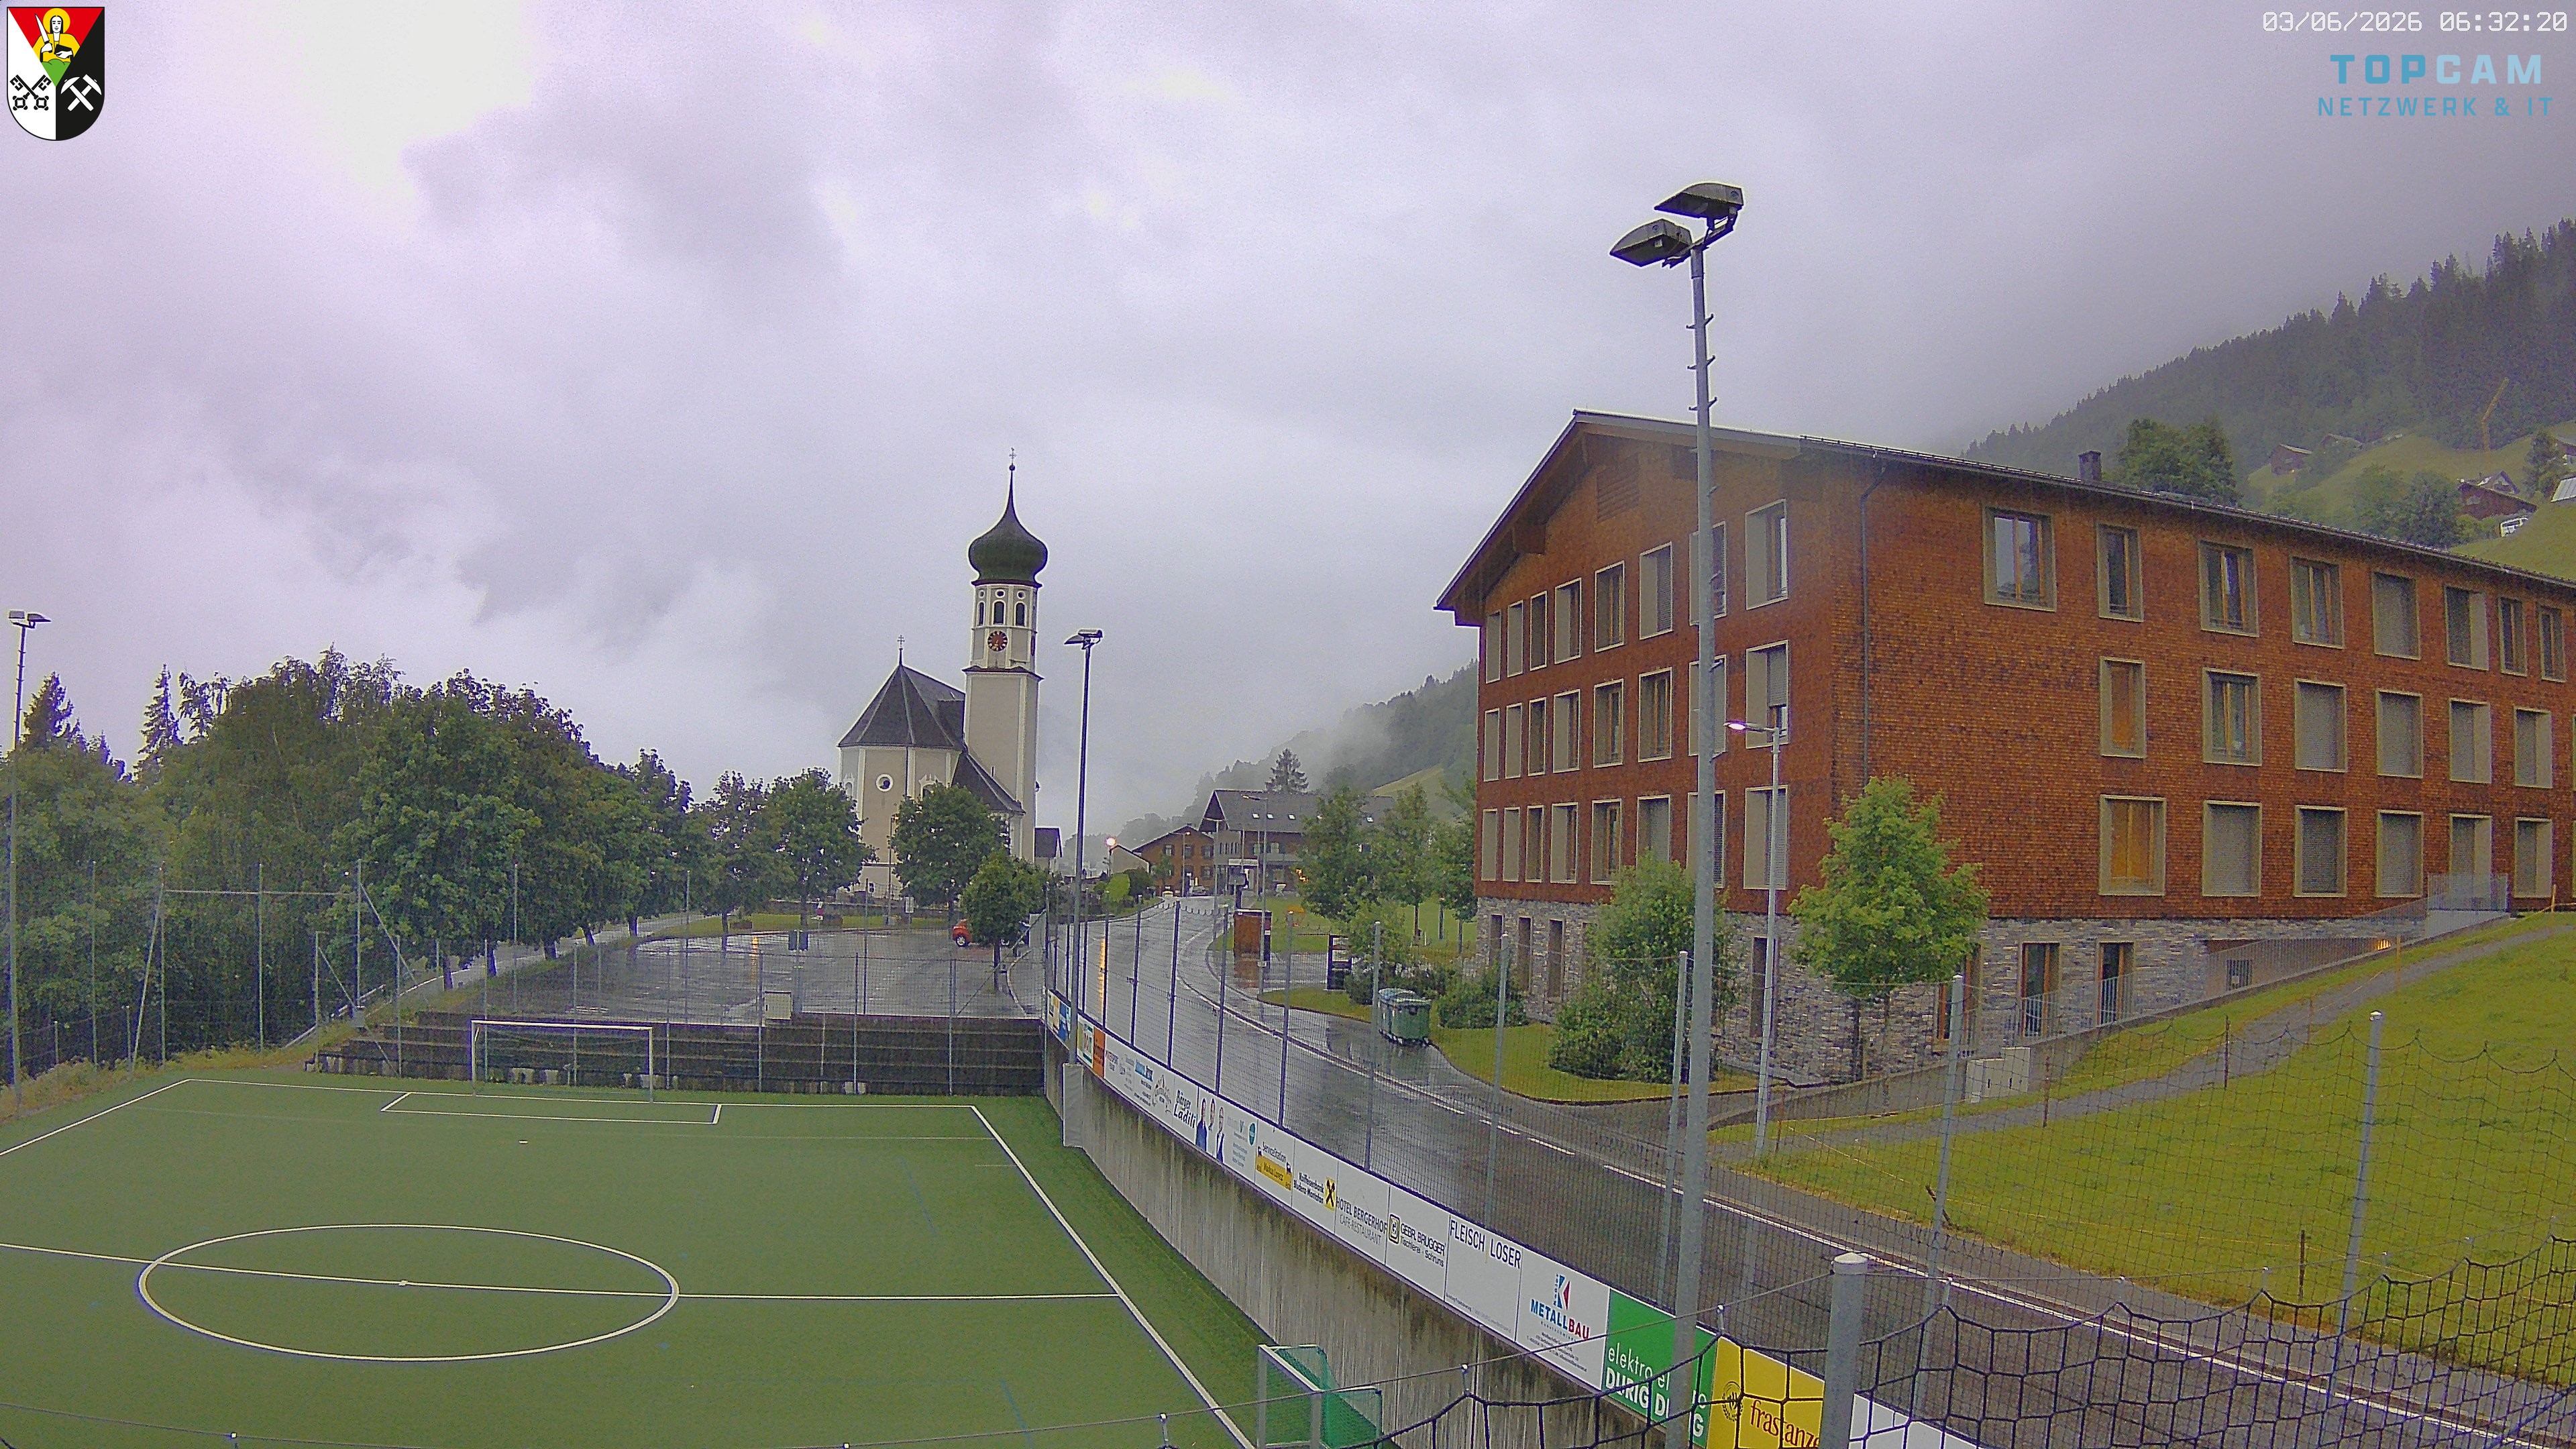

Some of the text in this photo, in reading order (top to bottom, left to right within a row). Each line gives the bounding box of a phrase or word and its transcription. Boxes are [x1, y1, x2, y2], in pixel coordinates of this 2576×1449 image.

[1336, 1197, 1352, 1216] HOTEL
[1354, 1206, 1387, 1234] BERGERHOF
[1417, 1232, 1445, 1256] BRUGGER
[1450, 1219, 1521, 1269] FLEISCH LOSER
[1531, 1299, 1590, 1340] METALLBAU
[1608, 1342, 1652, 1380] elektro
